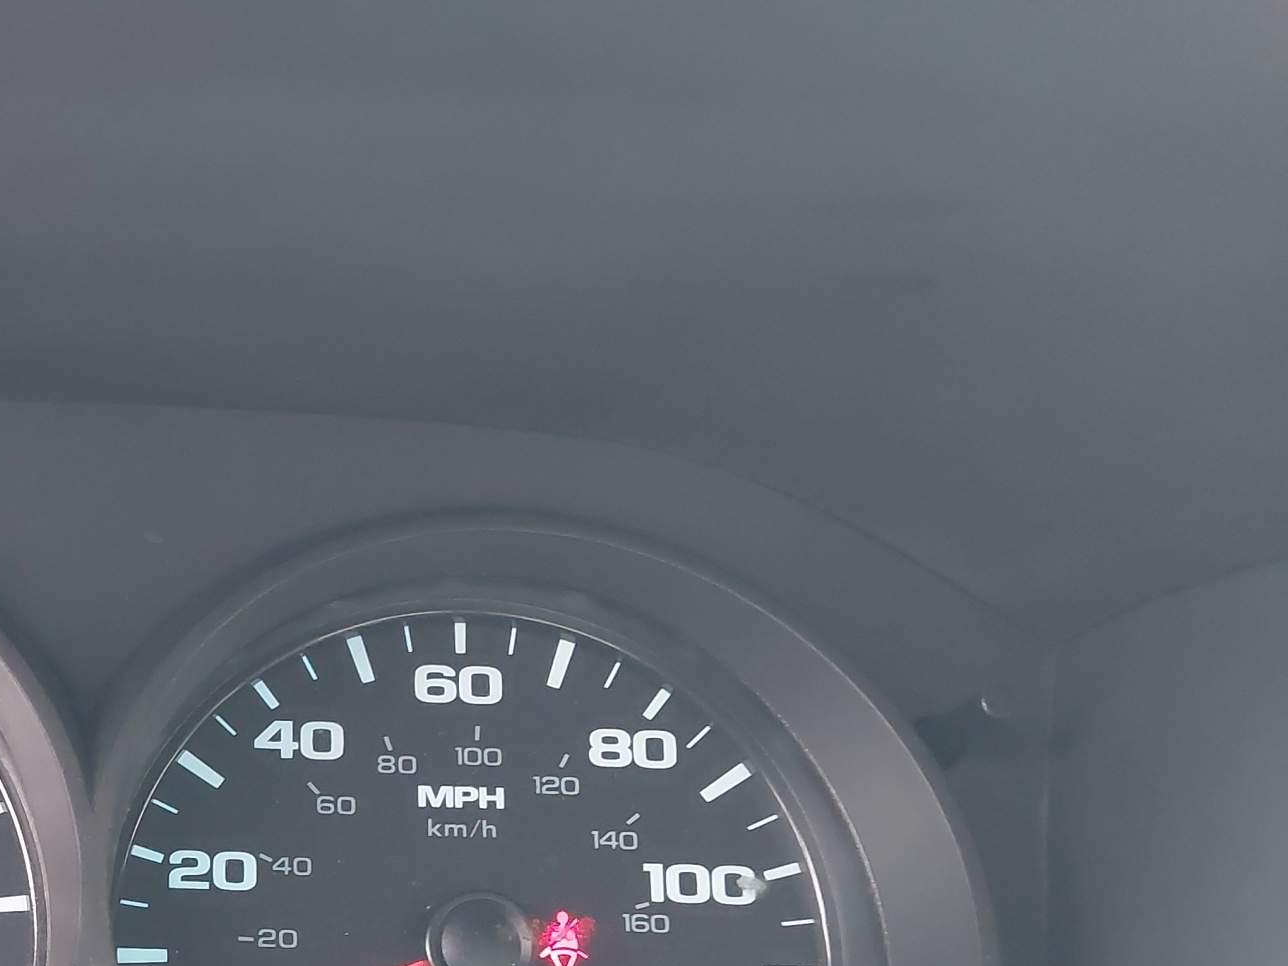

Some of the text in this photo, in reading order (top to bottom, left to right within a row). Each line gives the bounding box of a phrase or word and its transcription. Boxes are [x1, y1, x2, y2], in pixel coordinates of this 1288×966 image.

[414, 664, 503, 705] 60
[253, 720, 345, 761] 40
[588, 728, 677, 769] 80
[377, 755, 417, 775] 80
[455, 747, 502, 767] 100
[532, 776, 580, 796] 120
[316, 796, 356, 816] 60
[417, 784, 505, 811] MPH
[427, 818, 497, 839] km/h
[591, 830, 638, 850] 140
[168, 849, 258, 891] 20
[271, 856, 312, 876] 40
[642, 863, 759, 906] 100
[622, 913, 670, 934] 160
[257, 928, 298, 949] 20
